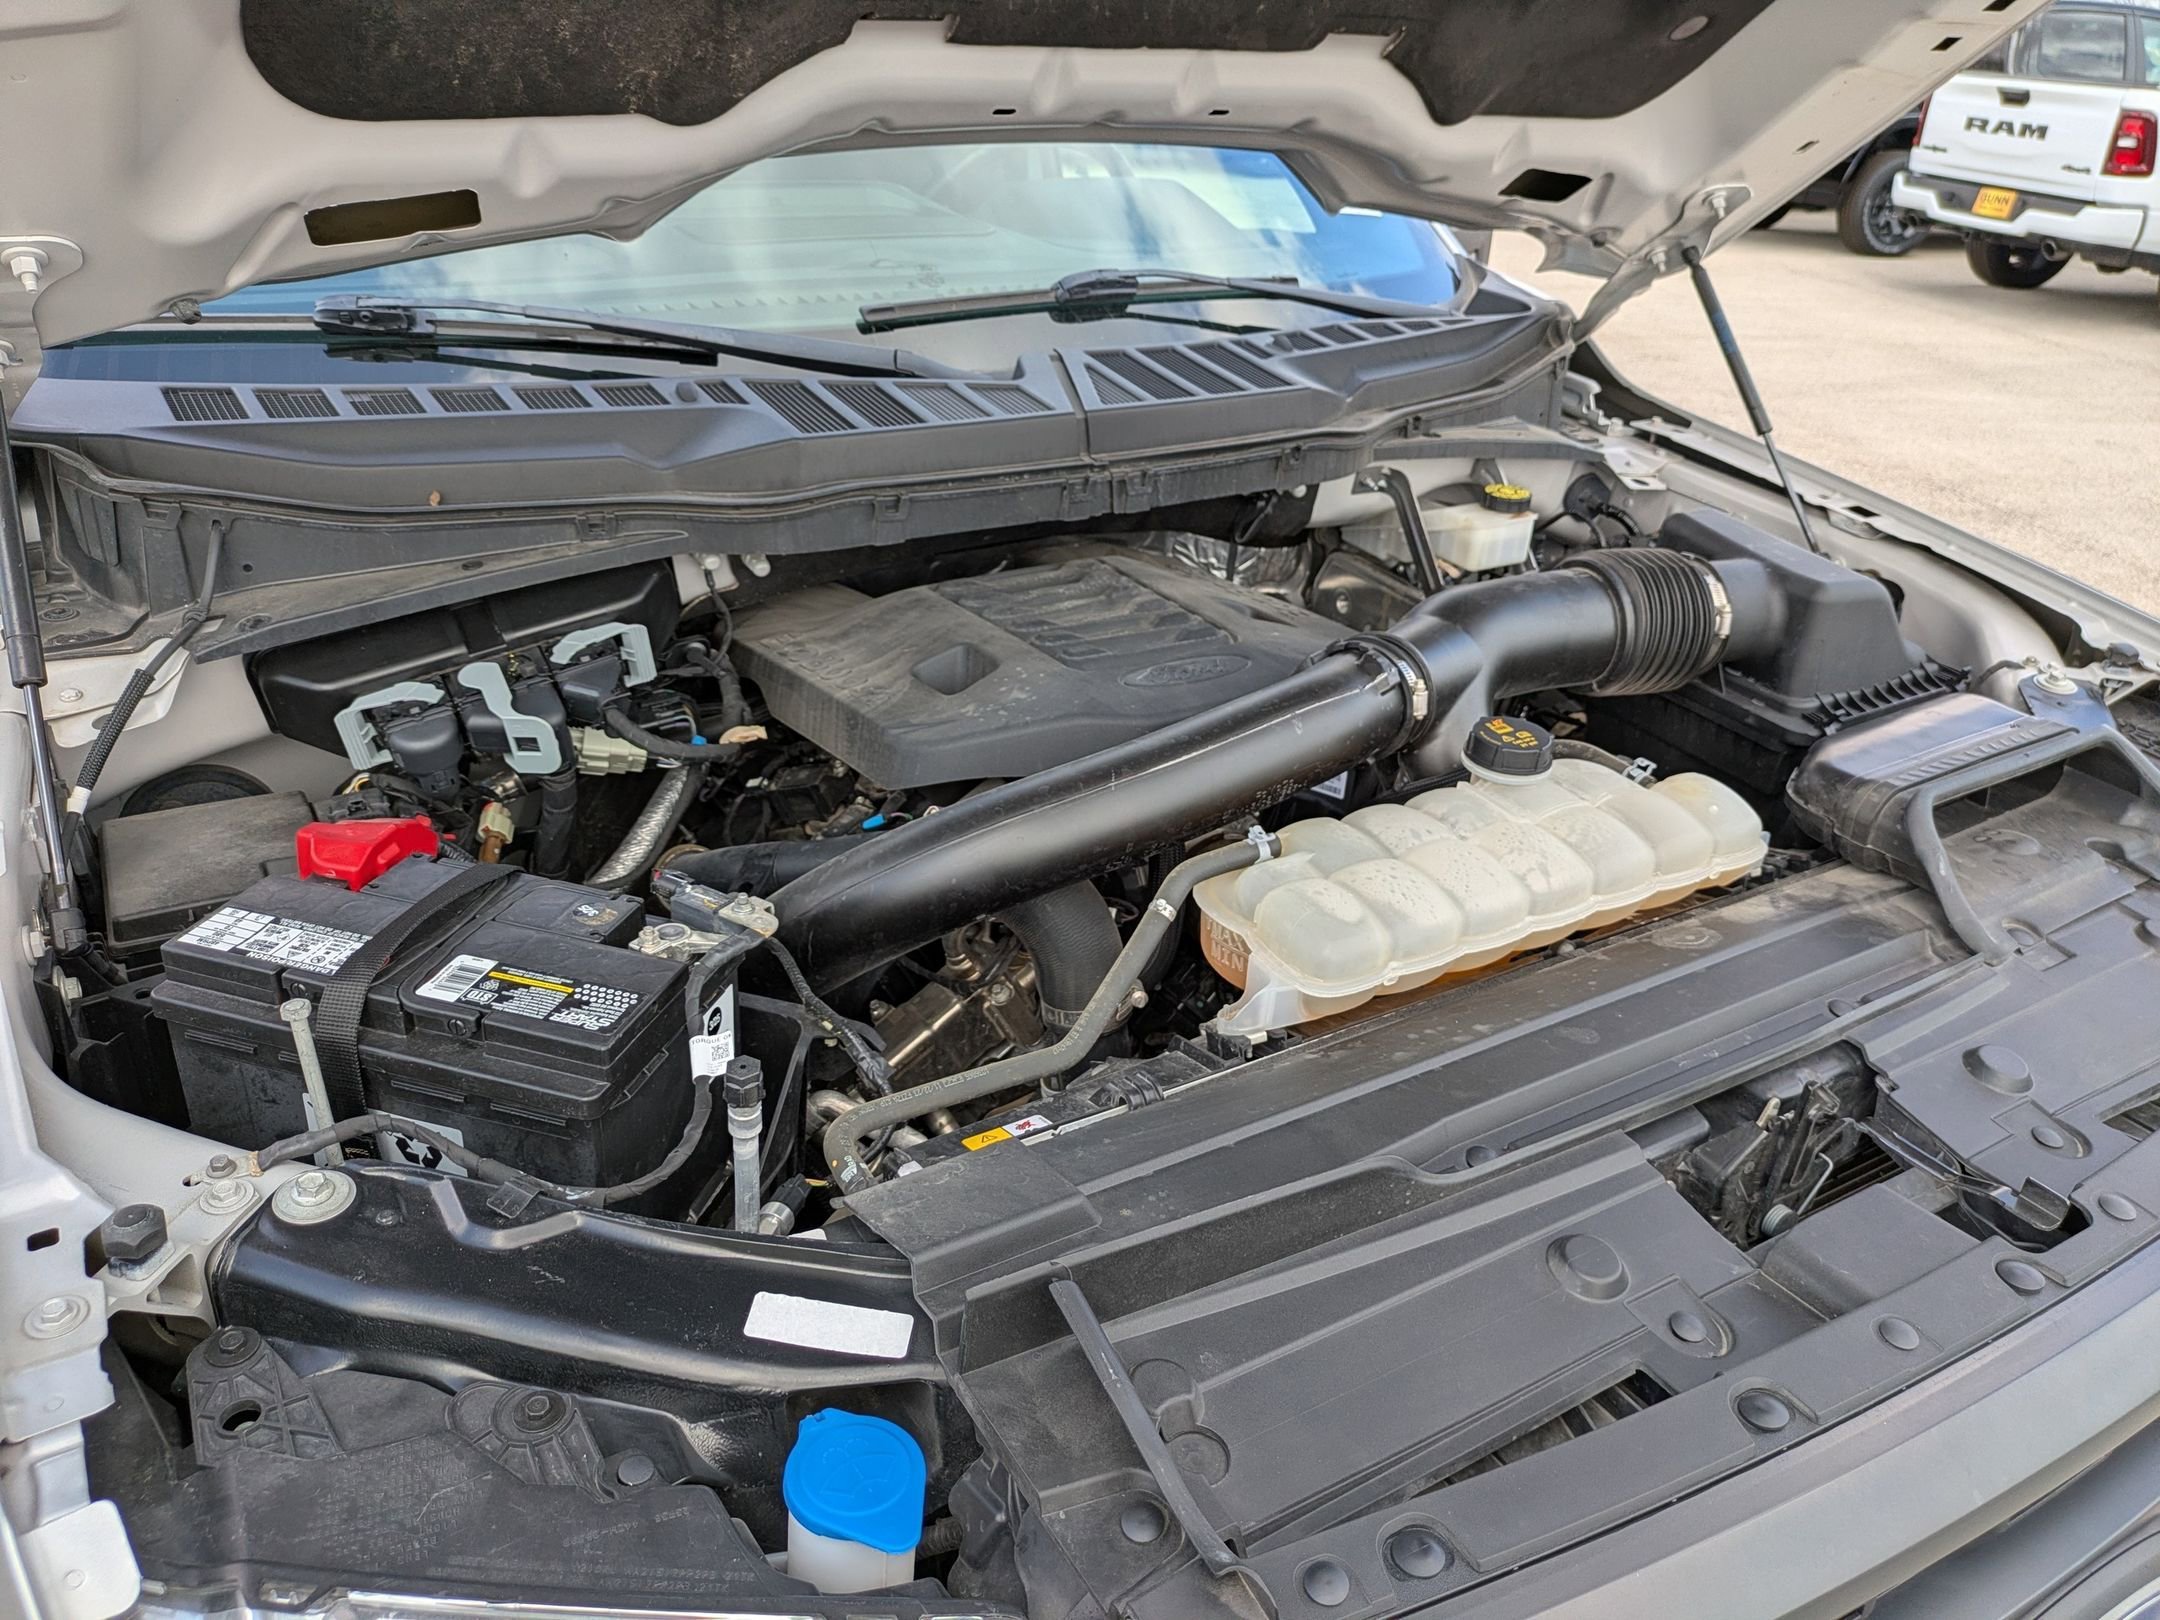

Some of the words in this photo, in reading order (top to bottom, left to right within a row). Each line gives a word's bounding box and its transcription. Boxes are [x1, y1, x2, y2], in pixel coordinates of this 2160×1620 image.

[1963, 116, 2049, 141] RAM
[1211, 921, 1245, 952] MAX
[246, 952, 286, 964] POISON
[1211, 939, 1244, 972] MIN
[287, 961, 331, 974] DANGER
[549, 1013, 599, 1030] SUPER
[555, 1010, 616, 1027] START
